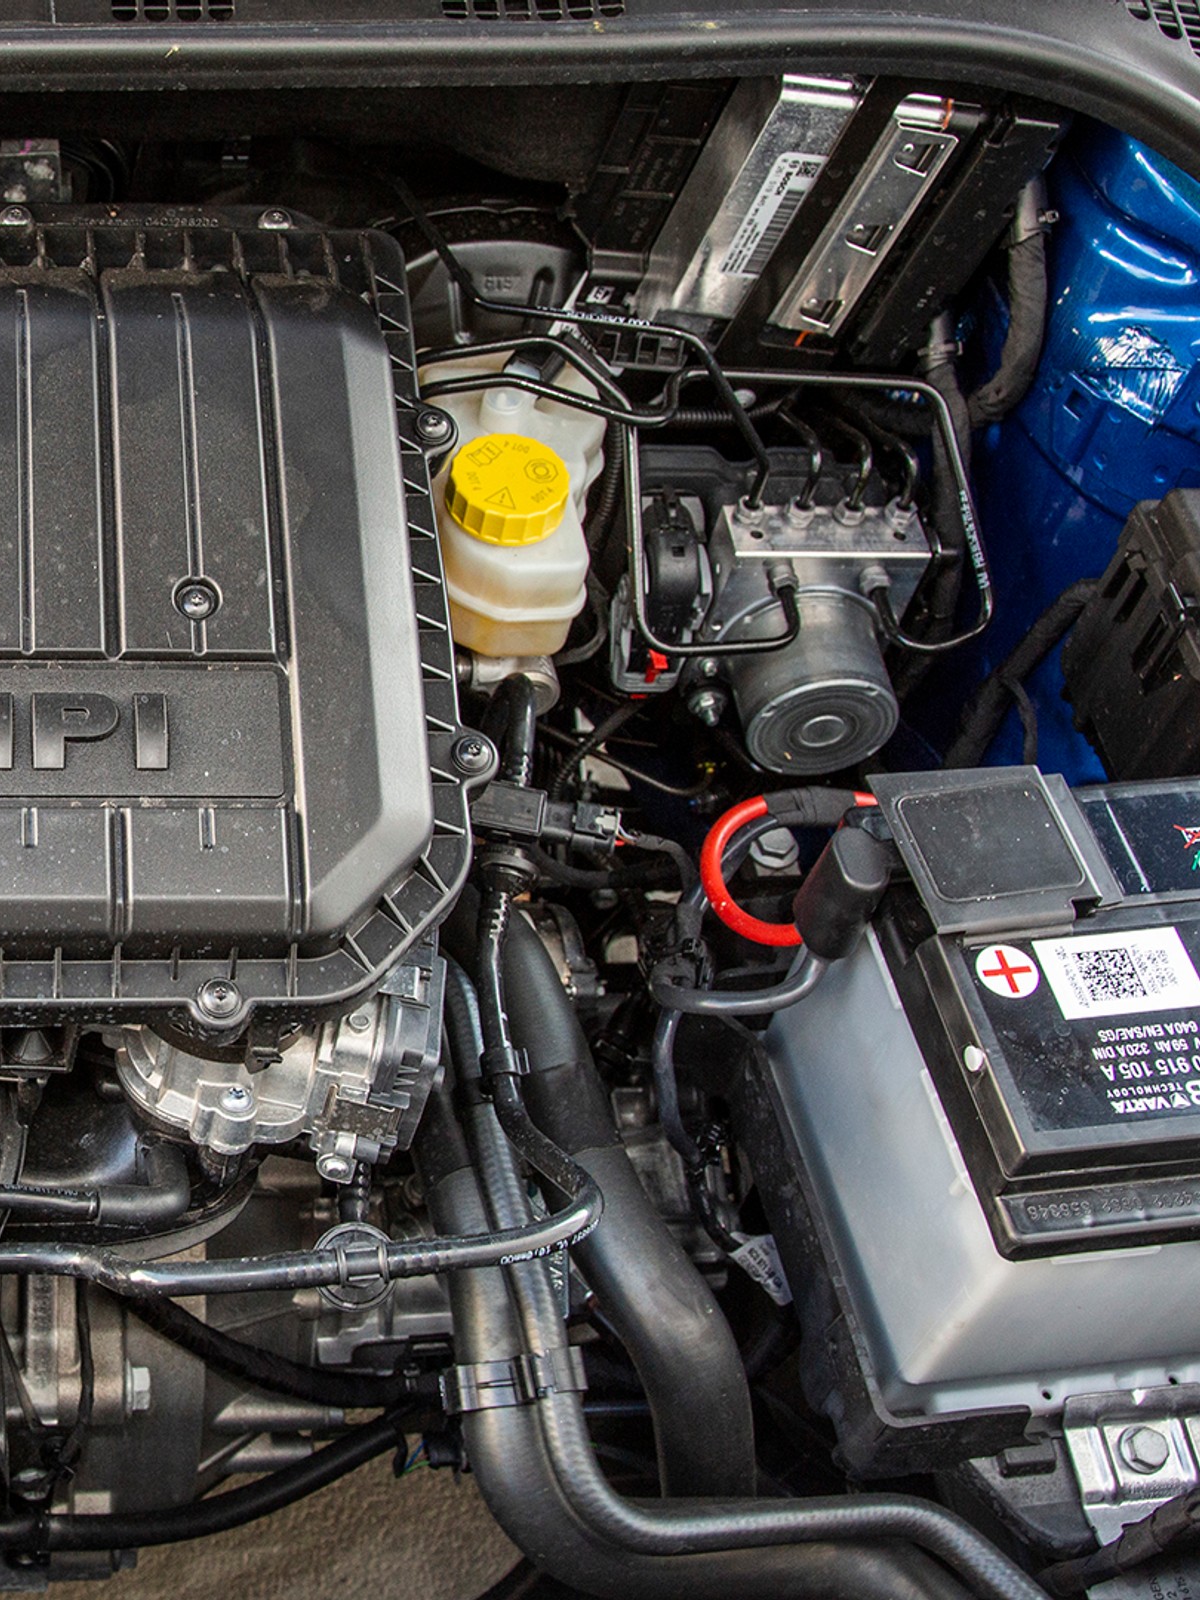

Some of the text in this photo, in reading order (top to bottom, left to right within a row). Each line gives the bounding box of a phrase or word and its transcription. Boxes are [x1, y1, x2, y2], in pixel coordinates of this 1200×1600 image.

[504, 440, 530, 454] DOT 4
[466, 472, 481, 484] DOT
[531, 489, 548, 503] DOT
[1097, 1020, 1199, 1042] 640A EN/SAE/GS
[1092, 1045, 1116, 1060] DIN
[1115, 1042, 1150, 1057] 320A
[1154, 1038, 1189, 1053] 59Ah
[1100, 1064, 1116, 1081] A
[1118, 1061, 1153, 1079] 105
[1155, 1056, 1191, 1075] 915
[1106, 1082, 1183, 1098] TECHNOLOGY
[1110, 1096, 1171, 1114] VARTA
